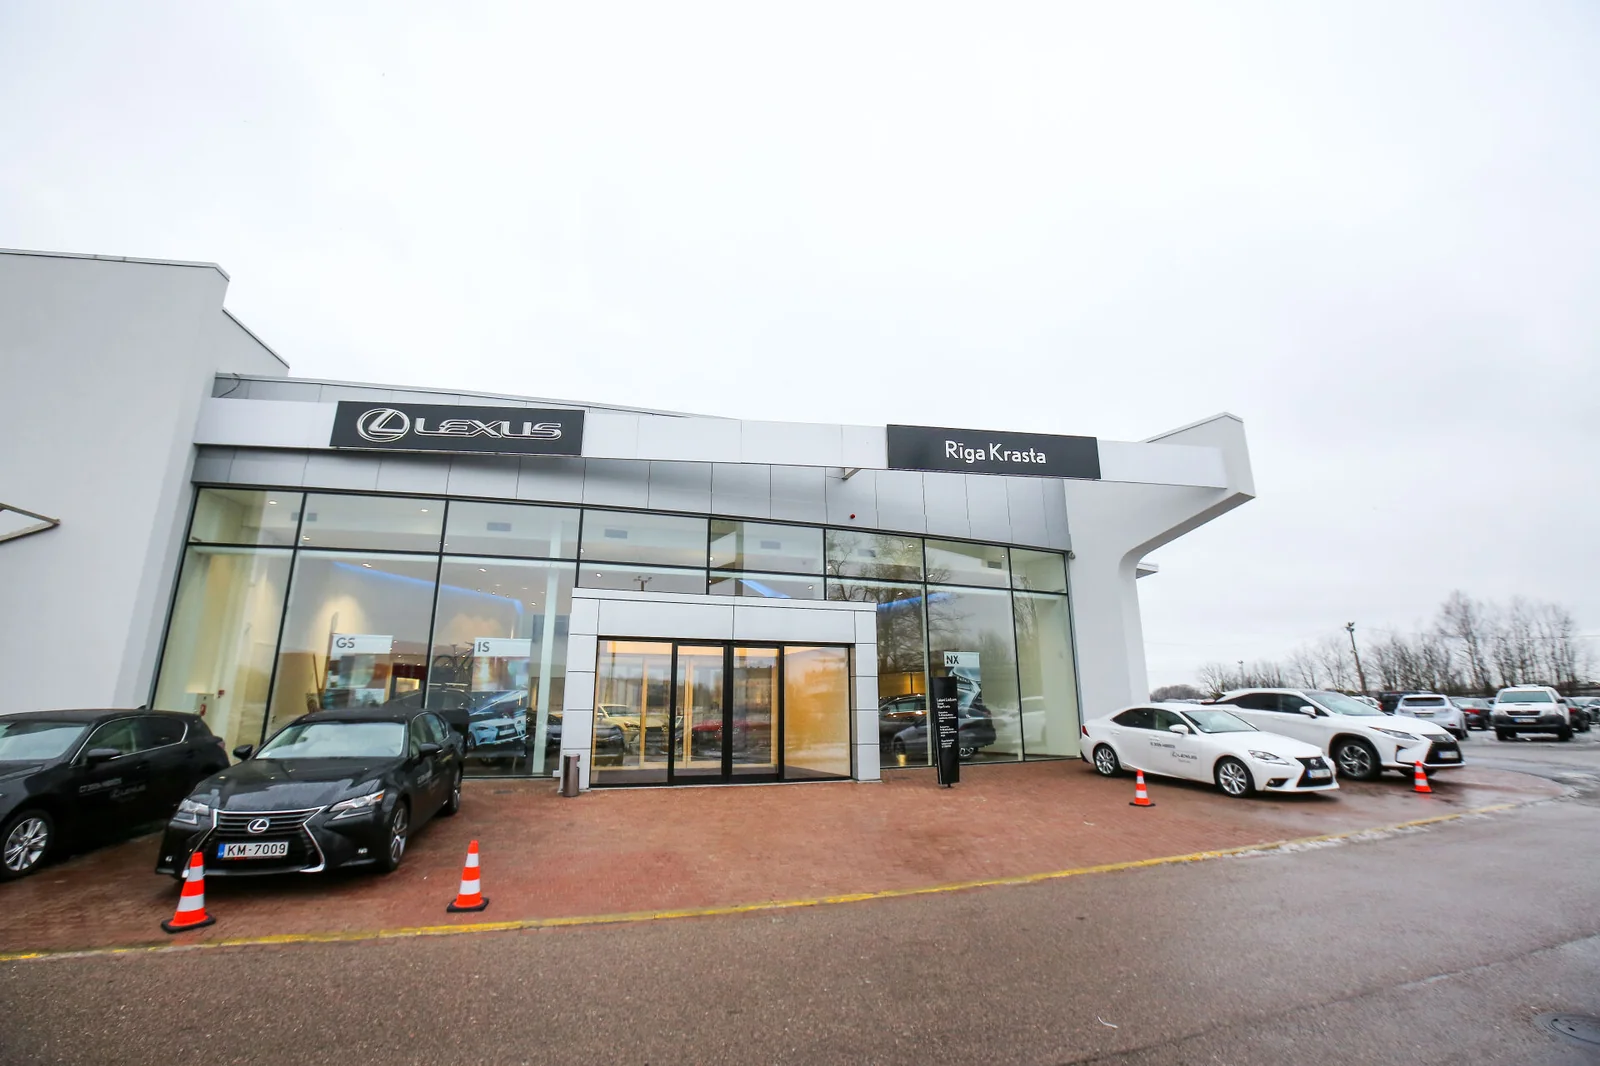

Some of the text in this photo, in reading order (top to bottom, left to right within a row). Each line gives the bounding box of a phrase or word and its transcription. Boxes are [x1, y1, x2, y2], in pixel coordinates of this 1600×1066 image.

[414, 417, 562, 441] LEXUS
[945, 440, 1046, 464] Rīga Krasta
[336, 637, 355, 649] GS
[477, 641, 490, 653] IS
[946, 655, 960, 664] NX
[227, 843, 286, 856] KM-7009
